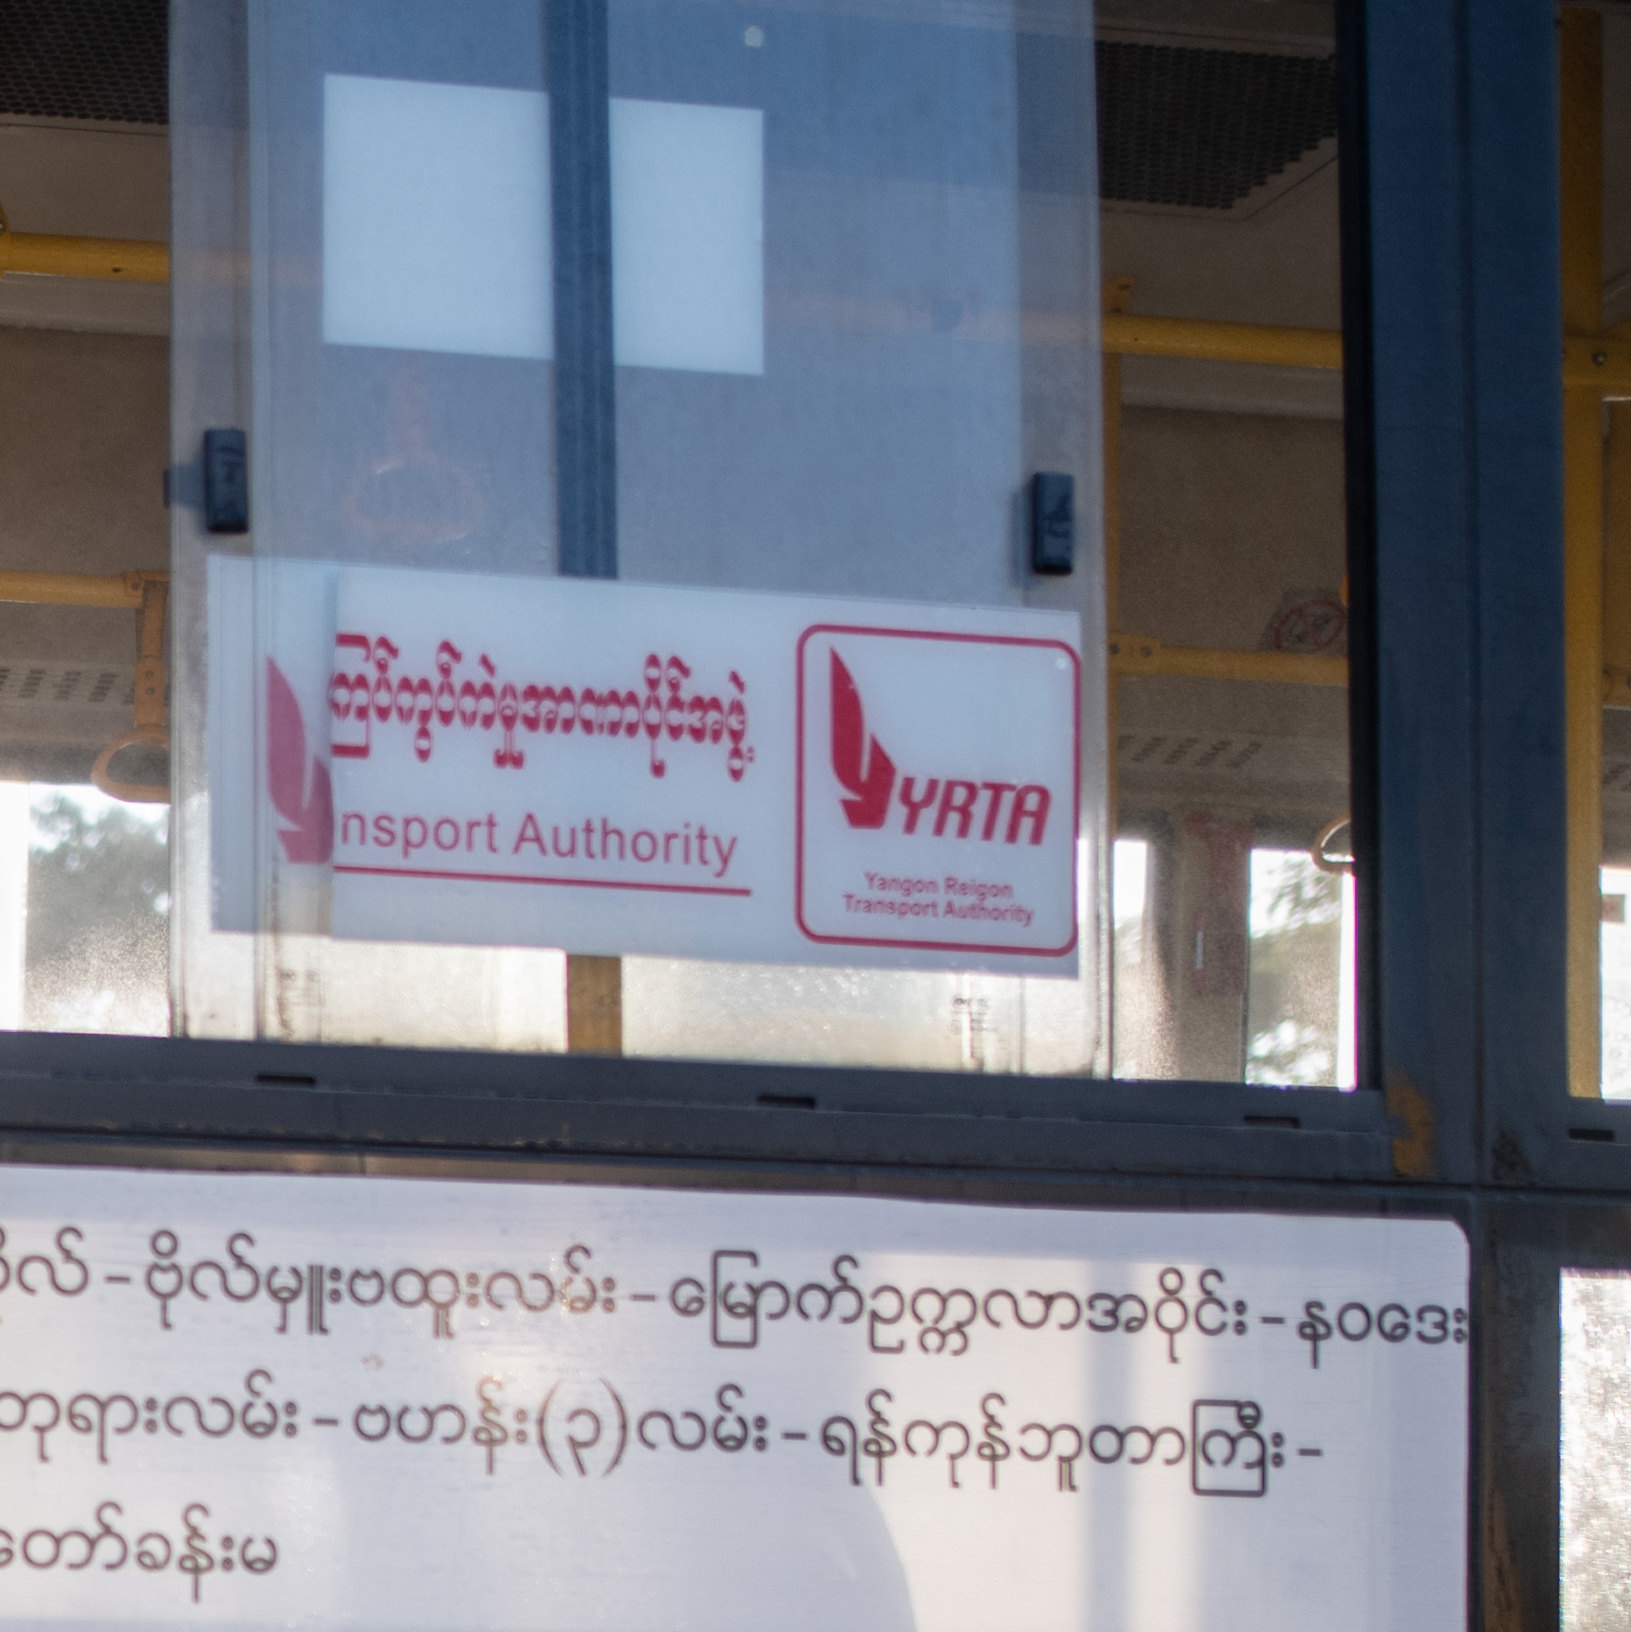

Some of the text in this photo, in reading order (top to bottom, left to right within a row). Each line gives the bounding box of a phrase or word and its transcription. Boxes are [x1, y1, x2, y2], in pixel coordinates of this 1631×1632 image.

[899, 776, 1051, 846] YRTA
[511, 812, 738, 878] Authority
[843, 893, 1034, 928] Transport Authority
[864, 872, 1014, 902] Yangon Reigon
